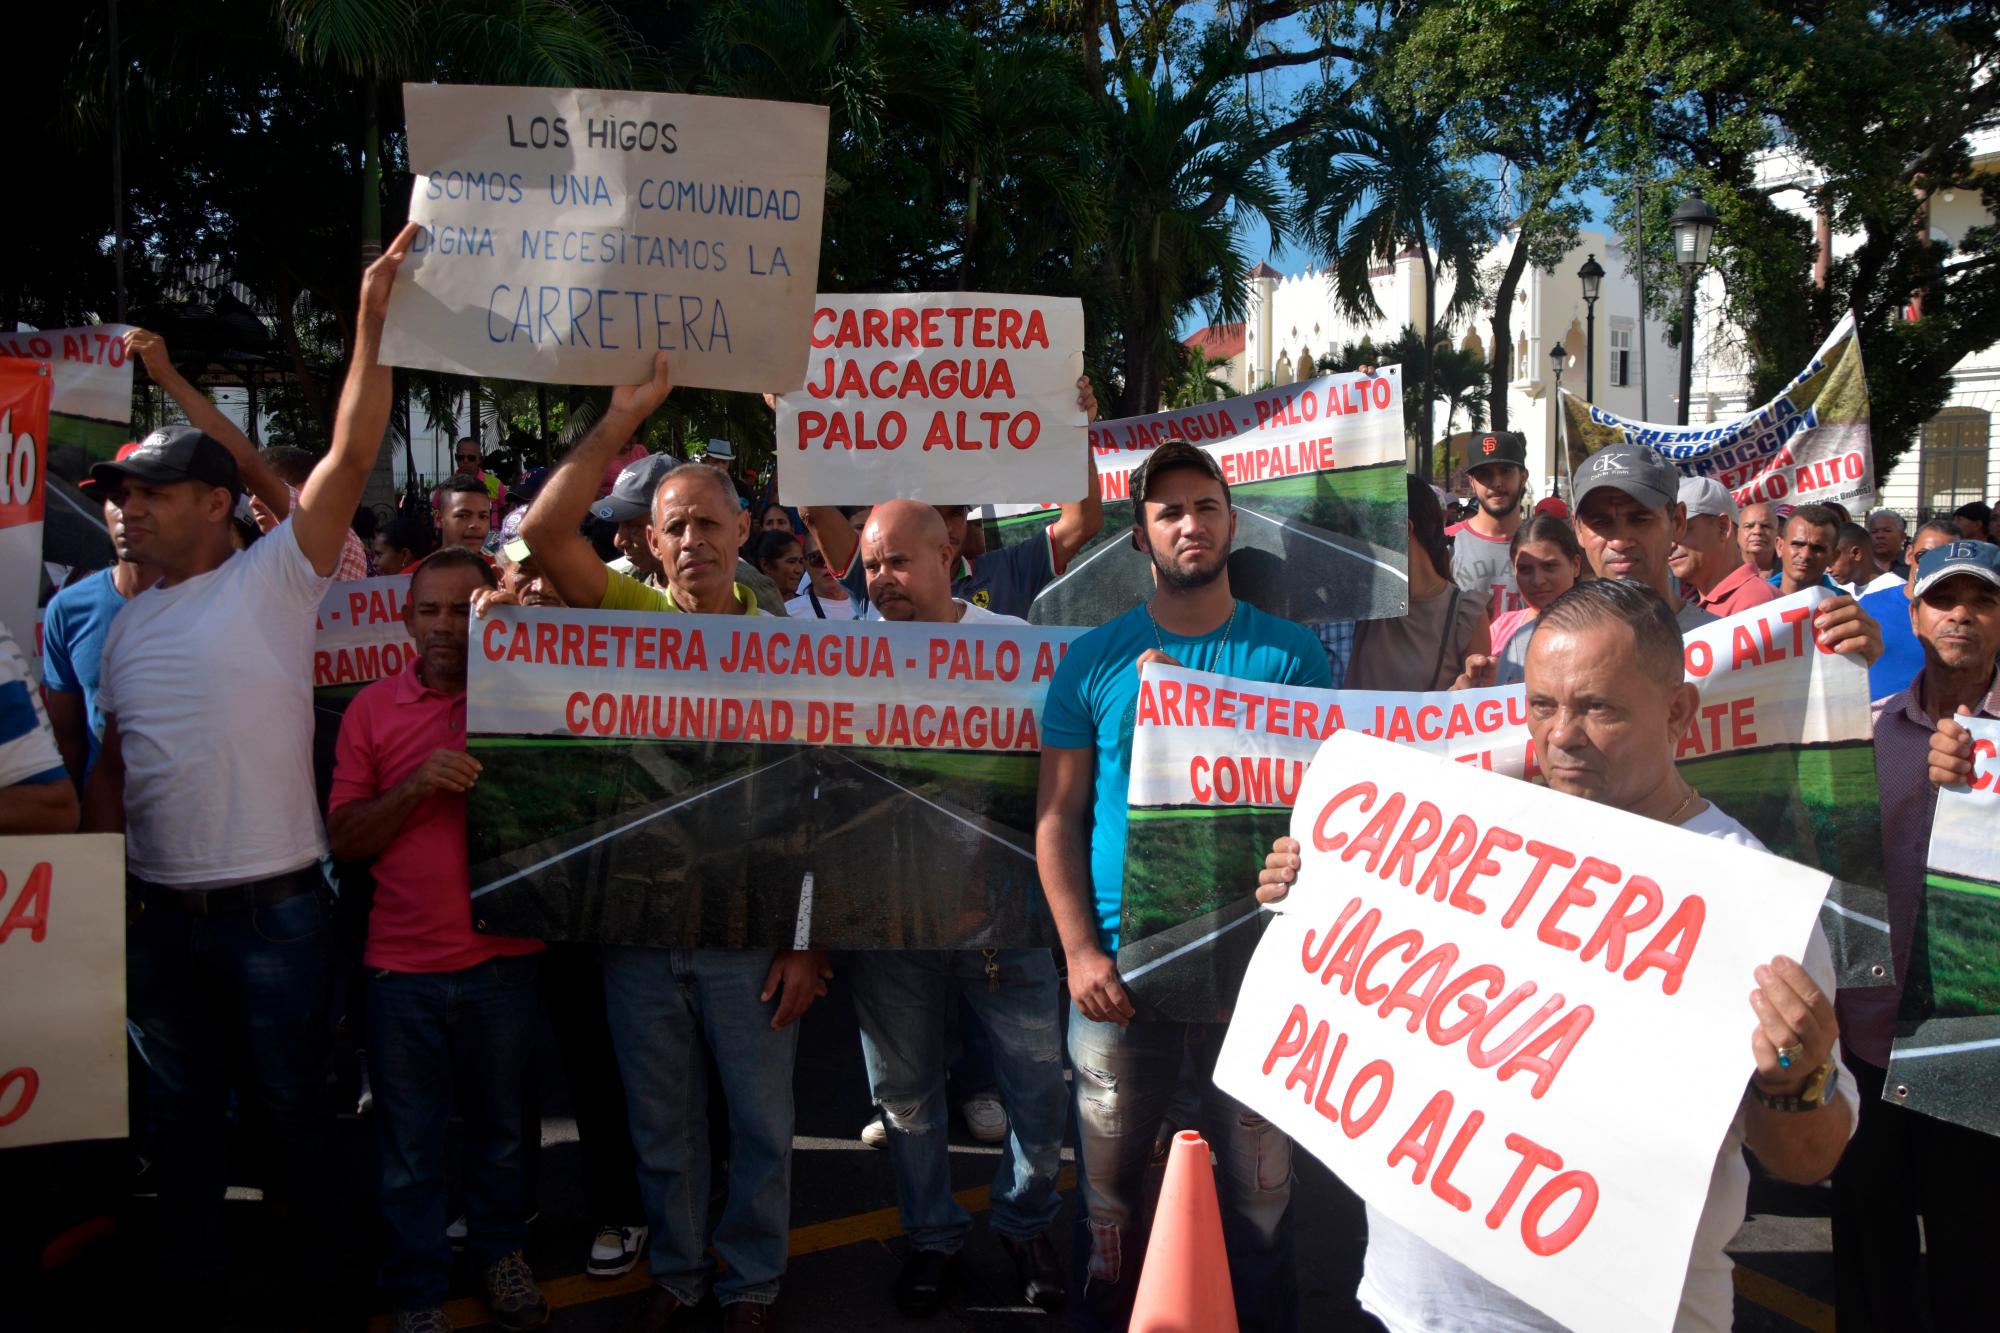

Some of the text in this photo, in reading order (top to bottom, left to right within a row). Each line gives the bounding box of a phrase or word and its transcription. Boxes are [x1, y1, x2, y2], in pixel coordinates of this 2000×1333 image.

[506, 114, 569, 149] LOS
[426, 170, 524, 204] SOMOS
[550, 175, 612, 207] UNA
[749, 244, 791, 277] LA
[487, 283, 732, 354] CARRETERA
[811, 307, 1049, 350] CARRETERA
[63, 334, 126, 369] ALTO
[806, 358, 1017, 400] JACAGUA
[797, 411, 1041, 451] PALO ALTO
[1125, 409, 1238, 452] JACAGUA
[1252, 389, 1318, 431] PALO
[1326, 377, 1391, 418] ALTO
[1221, 436, 1335, 485] EMPALME
[1795, 452, 1865, 494] ALTO
[349, 588, 413, 627] PAL
[482, 618, 708, 672] CARRETERA
[719, 630, 895, 678] JACAGUA
[928, 638, 1021, 683] PALO
[565, 691, 1039, 750] COMUNIDAD DE JACAGUA
[1135, 679, 1346, 741] ARRETERA
[1189, 755, 1319, 806] COMU
[1966, 737, 2000, 794] C
[0, 862, 53, 944] A
[1312, 780, 1708, 996] CARRETERA
[1301, 896, 1596, 1100] JACAGUA
[1261, 1003, 1600, 1257] PALO ALTO
